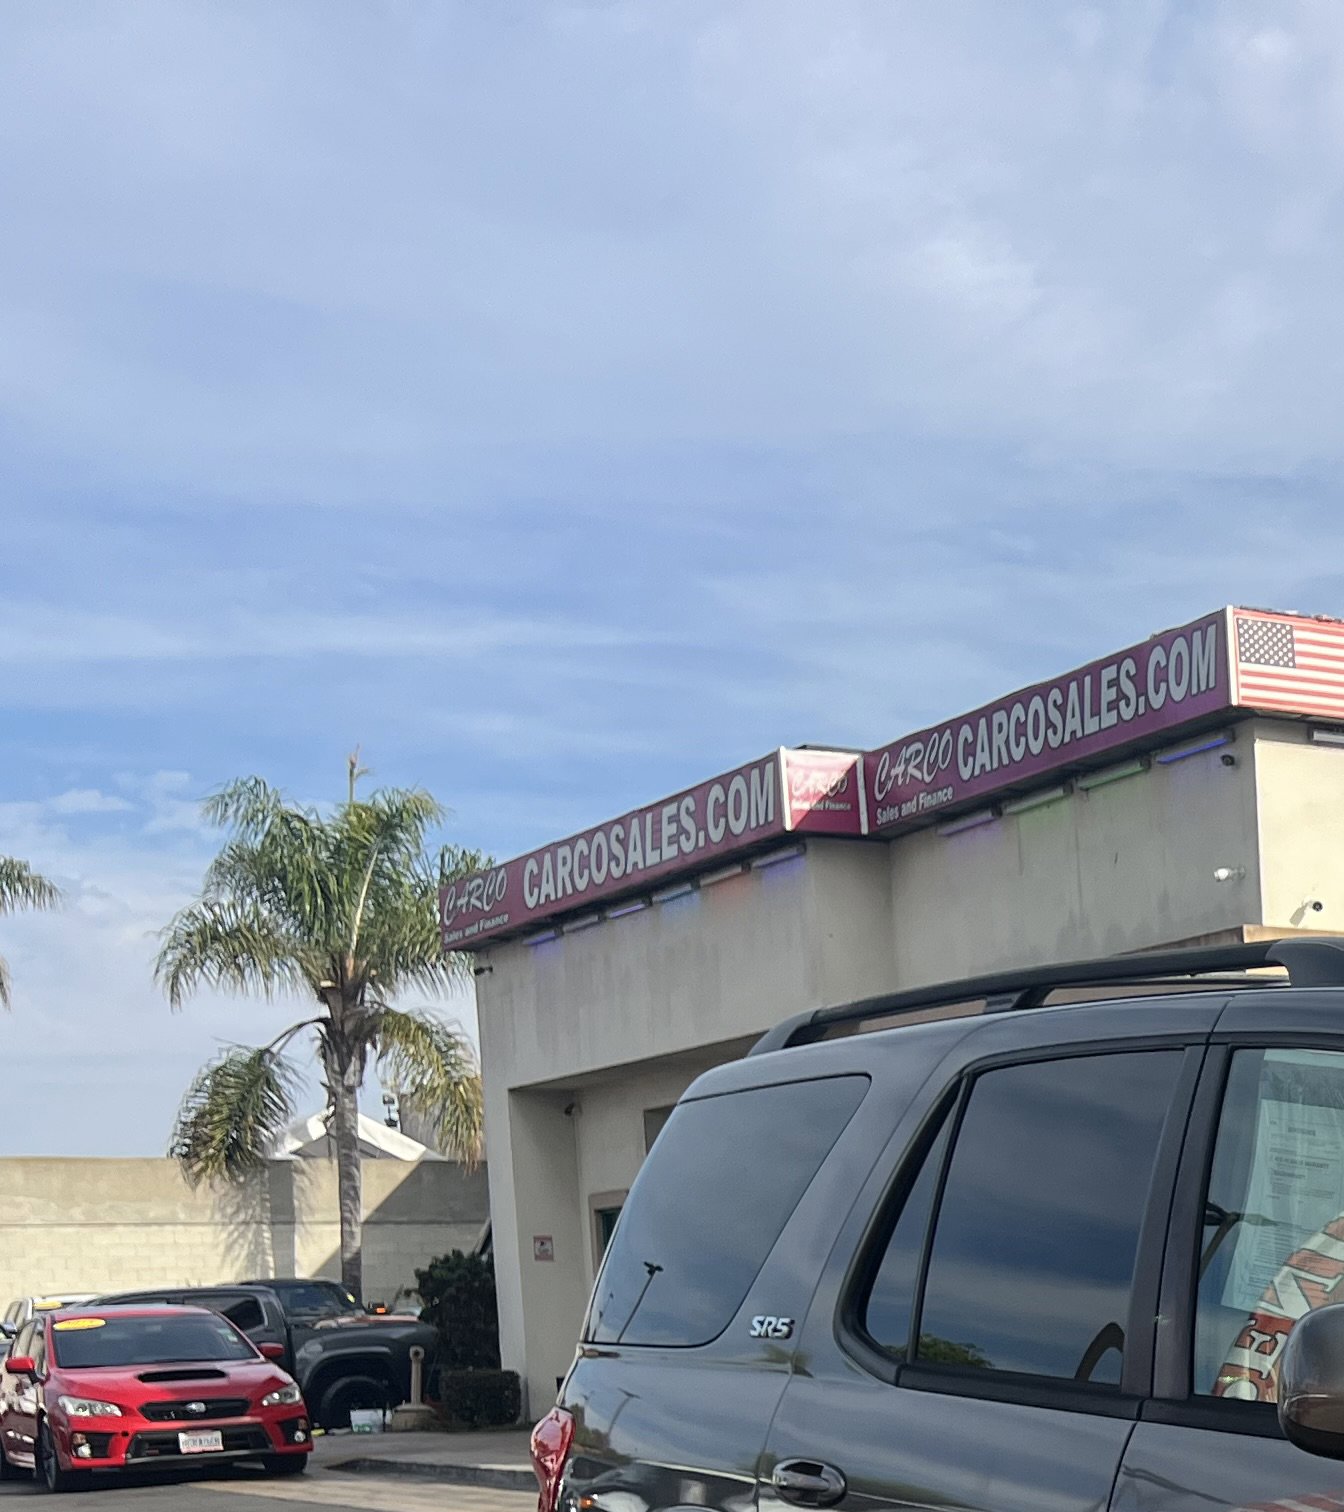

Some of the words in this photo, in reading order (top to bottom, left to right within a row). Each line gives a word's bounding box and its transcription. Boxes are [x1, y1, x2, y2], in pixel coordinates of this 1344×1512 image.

[957, 623, 1217, 782] CARCOSALES.COM
[523, 761, 774, 910] CARCOSALES.COM
[876, 804, 900, 826] Sales
[901, 794, 917, 816] and
[918, 786, 954, 811] Finance
[750, 1315, 791, 1338] SR5
